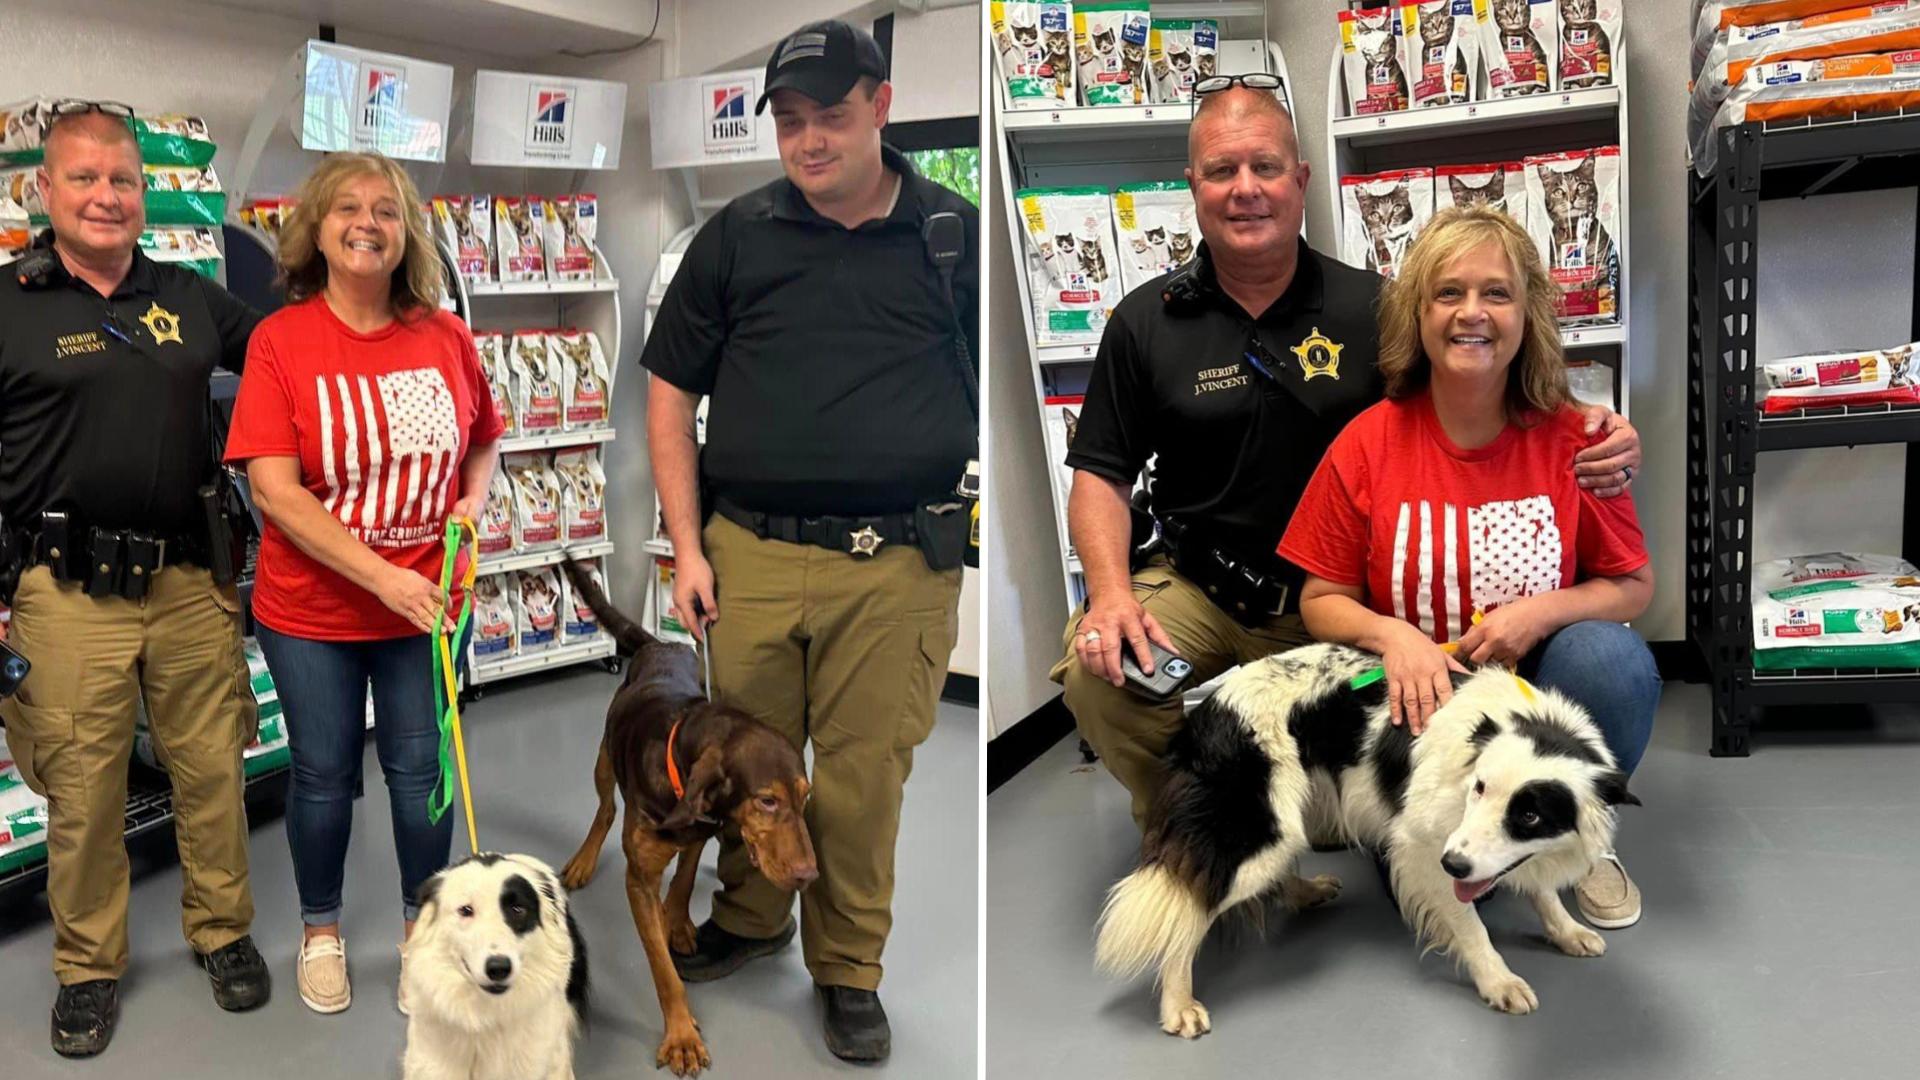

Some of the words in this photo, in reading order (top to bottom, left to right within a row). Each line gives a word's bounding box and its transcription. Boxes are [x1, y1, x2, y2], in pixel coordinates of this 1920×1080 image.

[1894, 54, 1913, 62] c/d
[1827, 64, 1850, 72] CARE
[533, 126, 565, 143] Hill's
[712, 120, 748, 140] Hill's
[57, 331, 97, 347] SHERIFF
[56, 341, 107, 359] J.VINCENT
[1198, 364, 1240, 381] SHERIFF
[1194, 375, 1248, 396] J.VINCENT
[365, 528, 388, 542] THE
